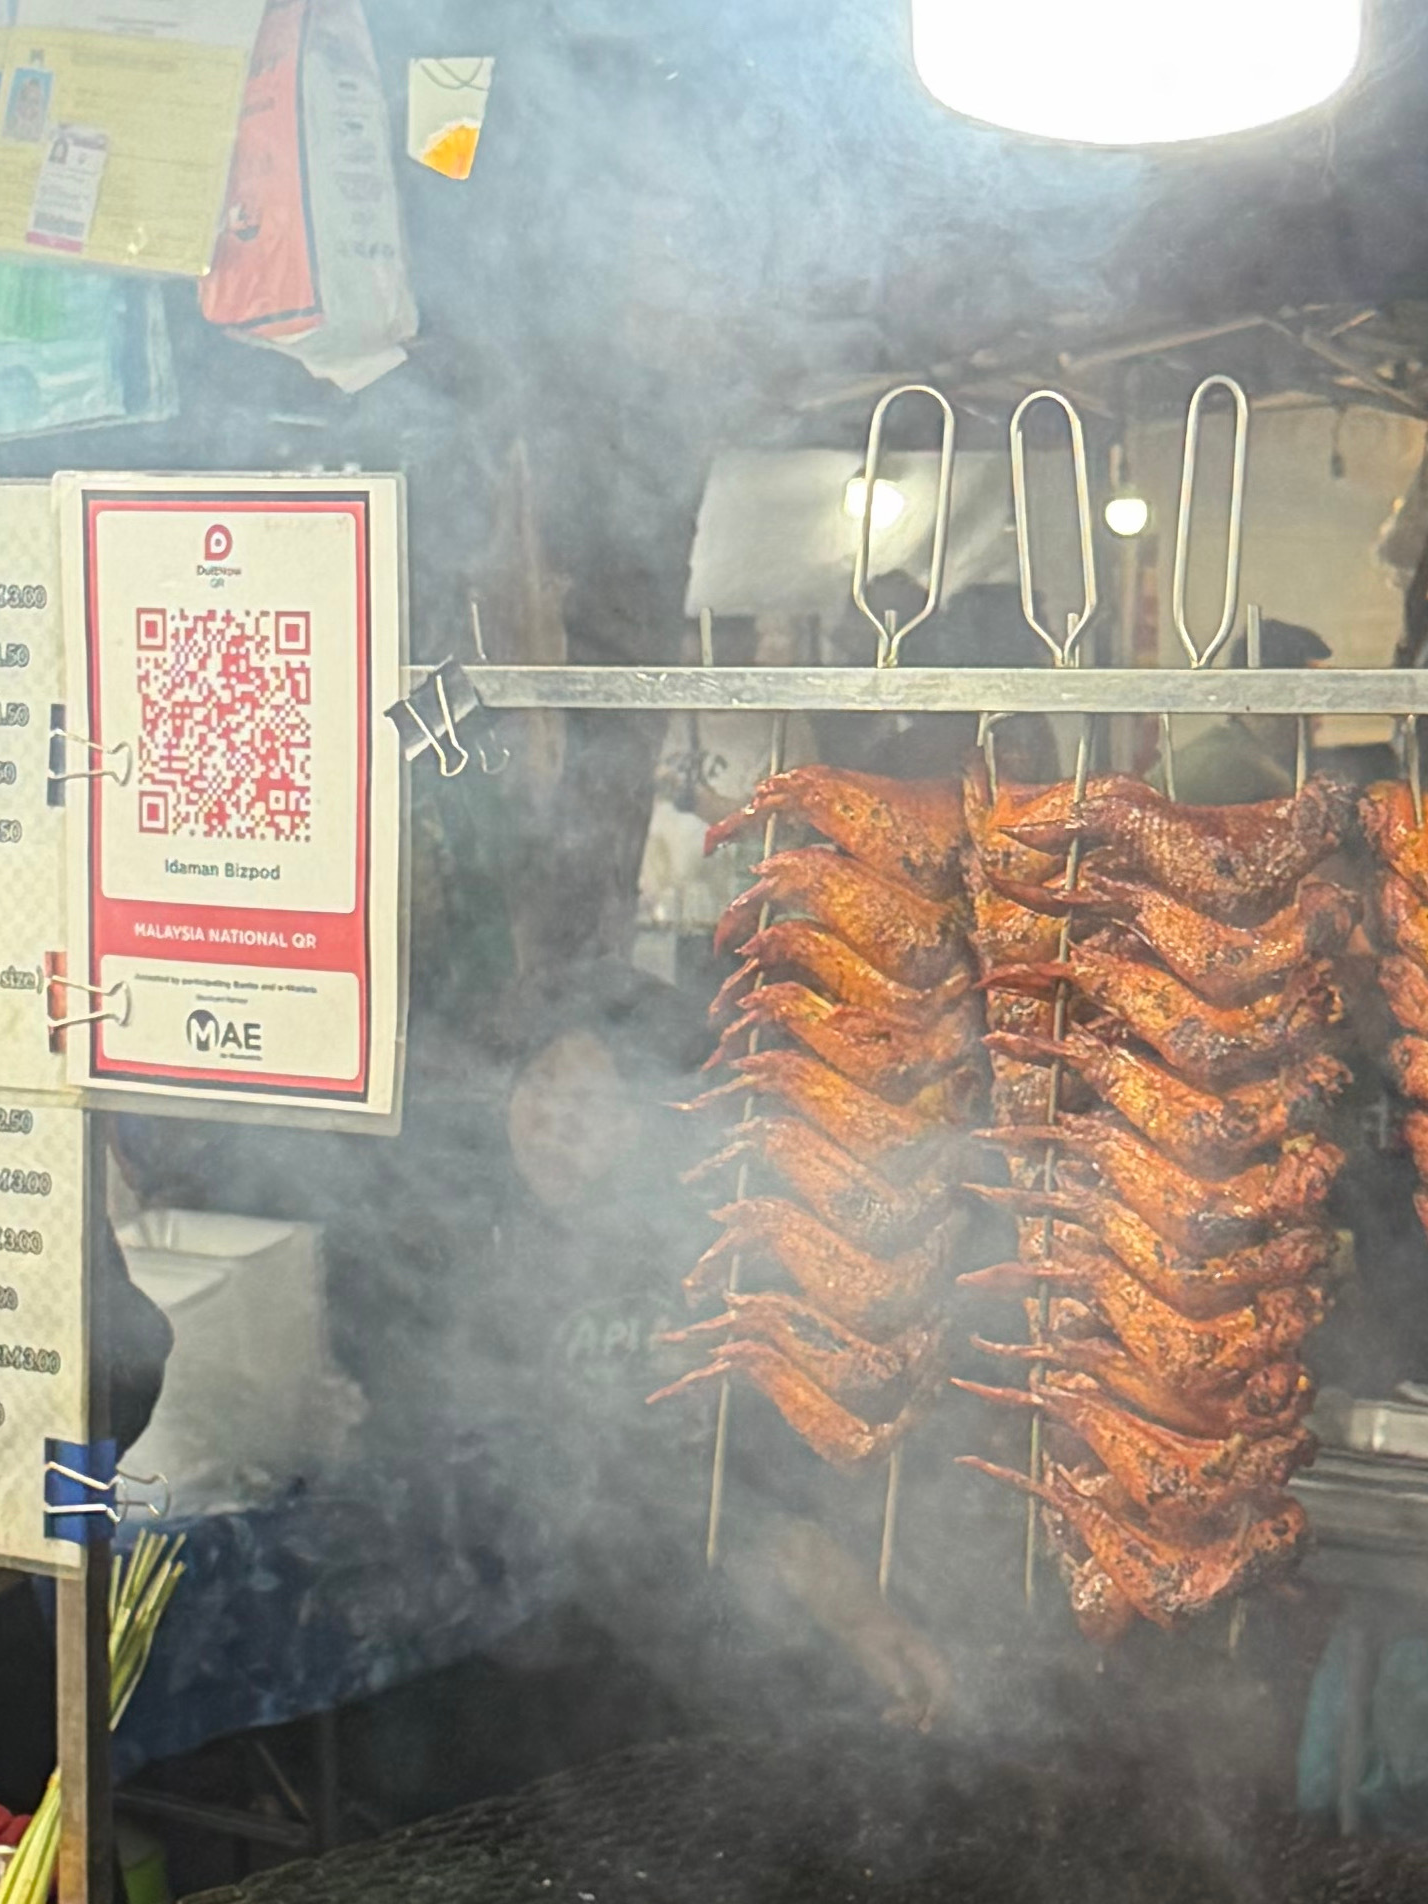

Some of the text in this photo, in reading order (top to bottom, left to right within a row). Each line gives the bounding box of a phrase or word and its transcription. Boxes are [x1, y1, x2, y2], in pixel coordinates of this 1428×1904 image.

[164, 859, 280, 881] Idaman Bizpod
[134, 922, 317, 949] MALAYSIA NATIONAL QR
[186, 1009, 262, 1052] MAE
